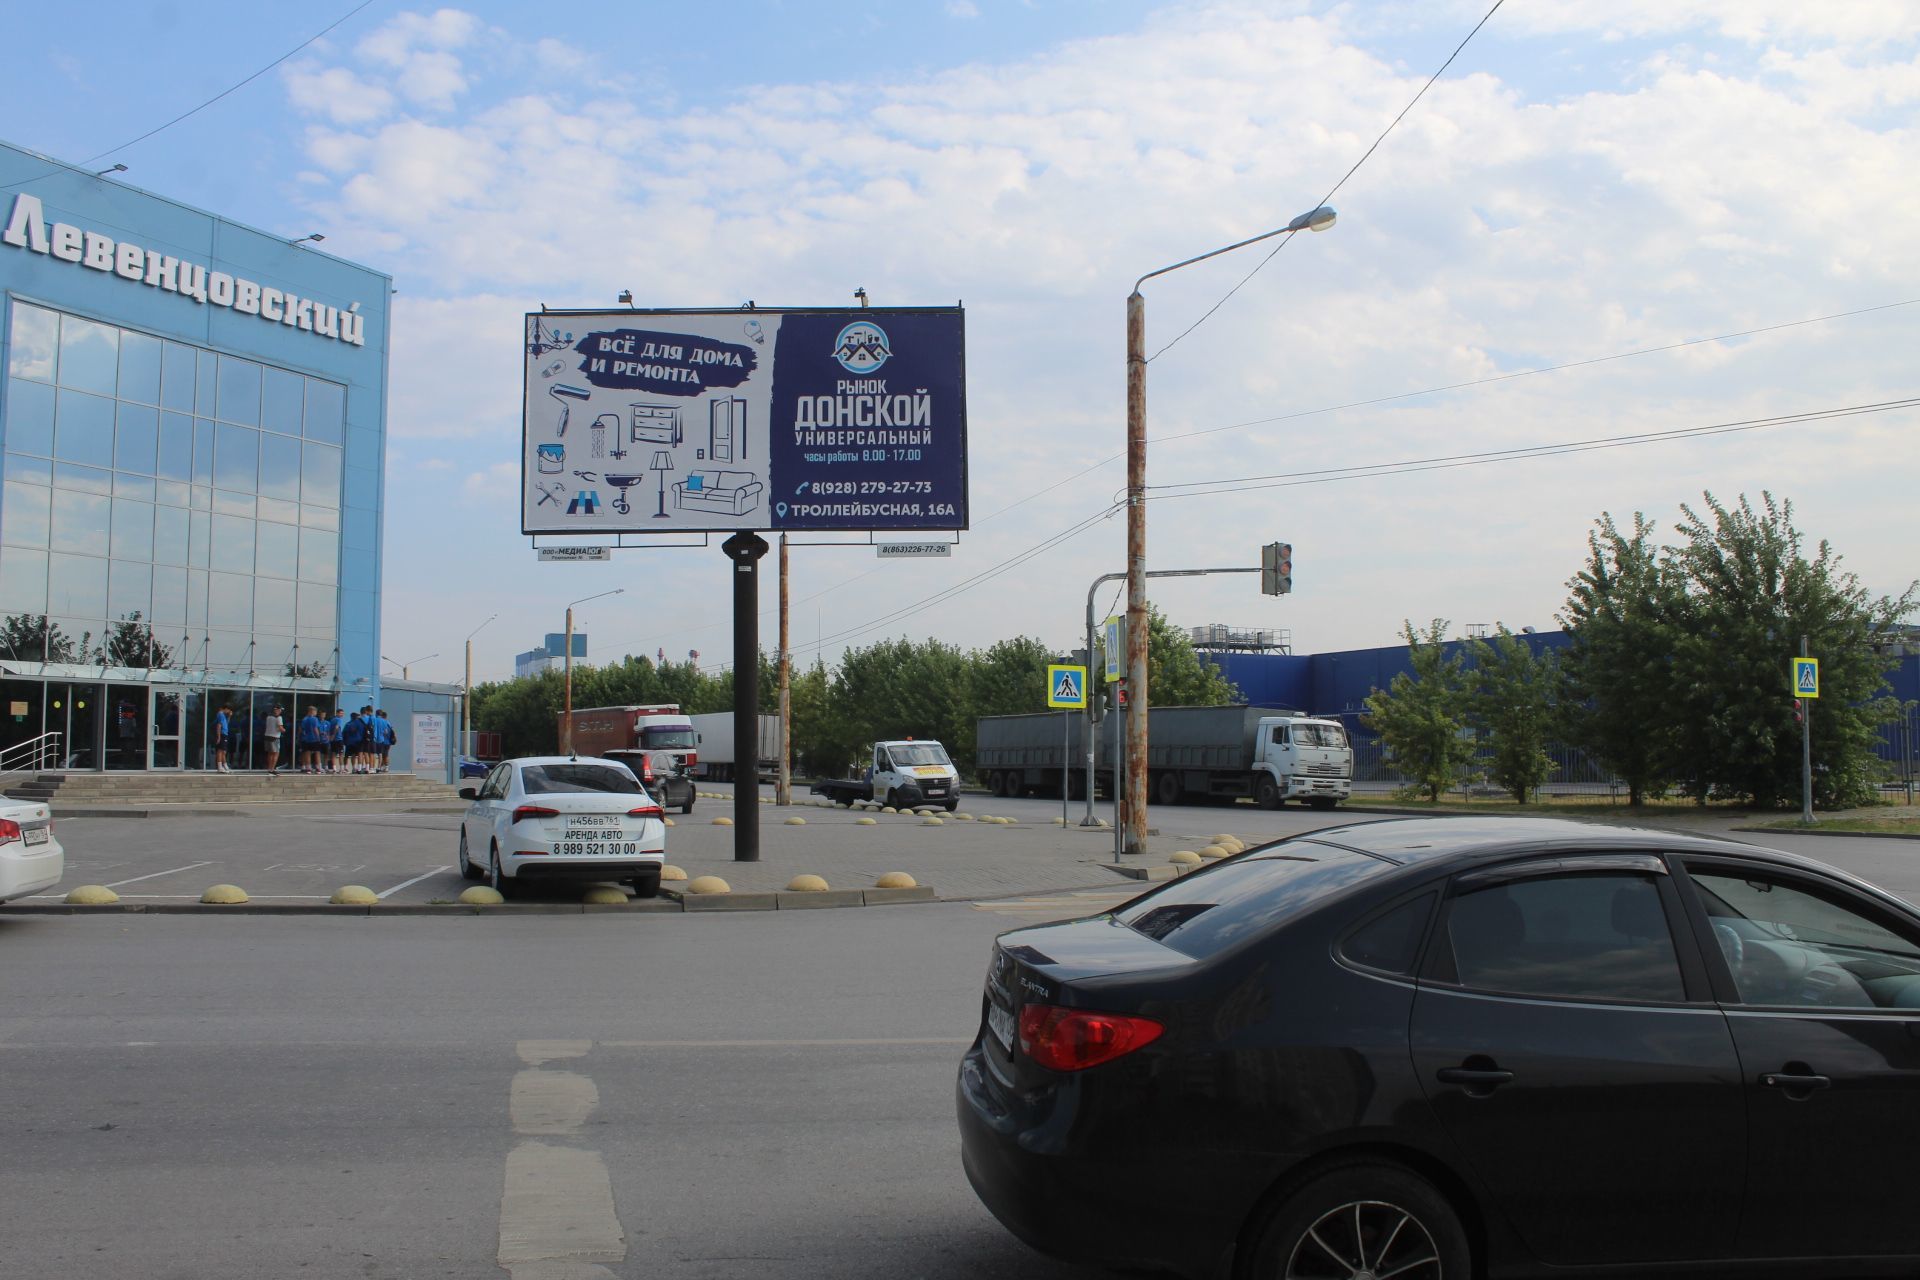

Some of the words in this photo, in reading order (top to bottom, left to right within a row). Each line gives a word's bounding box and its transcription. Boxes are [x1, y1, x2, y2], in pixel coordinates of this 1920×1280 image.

[3, 192, 365, 346] Левенцовский
[599, 335, 636, 355] ВСЁ
[640, 342, 683, 361] ДЛЯ
[689, 348, 743, 368] ДОМА
[590, 358, 606, 373] И
[613, 361, 700, 384] РЕМОНТА
[837, 380, 887, 394] РЫНОК
[795, 388, 931, 430] ДОНСКОЙ
[795, 428, 932, 445] УНИВЕРСАЛЬНЫЙ
[804, 453, 826, 462] часы
[827, 451, 858, 464] работы
[862, 450, 886, 461] 8.00
[893, 450, 921, 461] 17.00
[812, 482, 857, 495] 8(928)
[861, 482, 932, 494] 279-27-73
[791, 502, 924, 517] ТРОЛЛЕЙБУСНАЯ,
[928, 504, 955, 516] 16А
[565, 830, 598, 841] АРЕНДА
[601, 830, 623, 840] АВТО
[553, 843, 560, 854] 8
[563, 843, 583, 854] 989
[586, 843, 604, 854] 521
[608, 843, 620, 854] 30
[623, 843, 636, 854] 00
